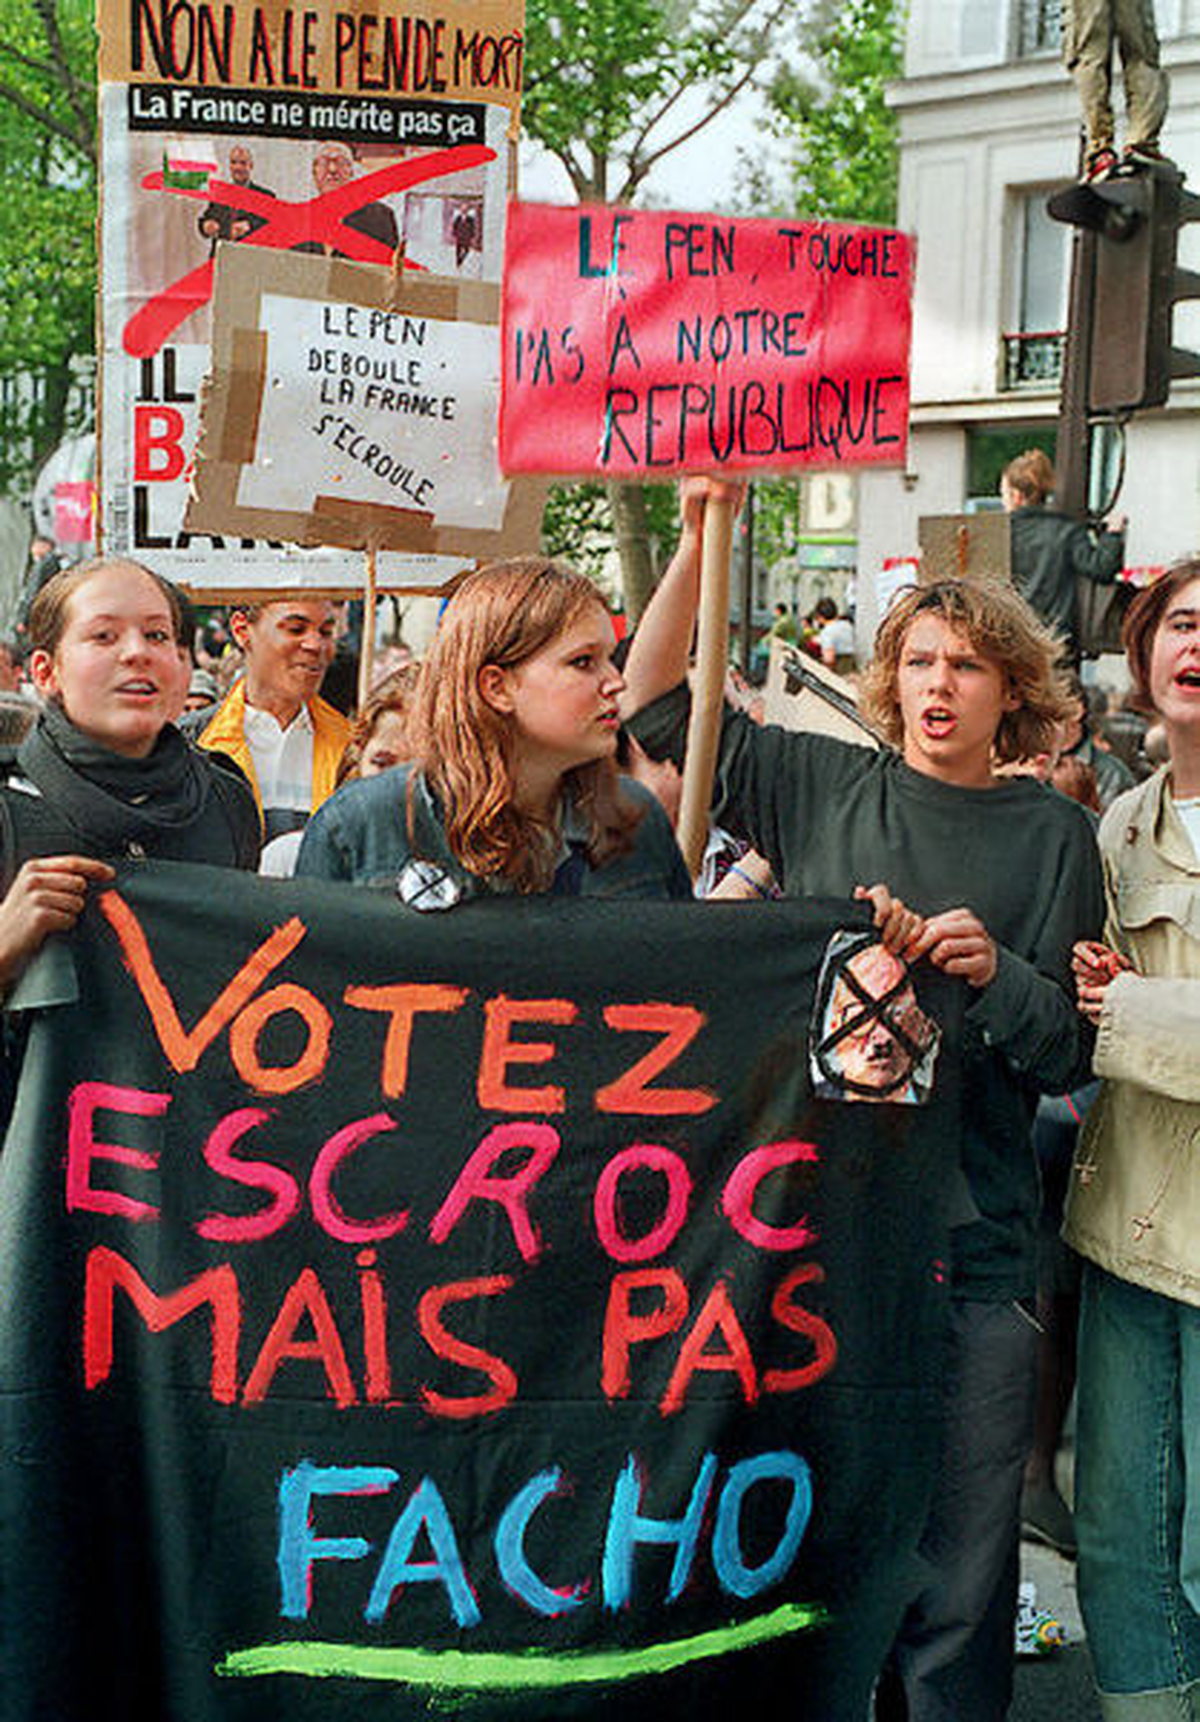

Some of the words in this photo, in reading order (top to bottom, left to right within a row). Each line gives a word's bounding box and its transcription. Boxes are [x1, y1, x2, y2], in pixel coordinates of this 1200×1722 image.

[131, 0, 235, 83] NON
[249, 7, 276, 86] A
[282, 10, 318, 89] LE
[453, 28, 525, 92] MORT
[133, 88, 168, 119] La
[172, 89, 266, 124] France
[271, 101, 304, 126] ne
[309, 99, 394, 131] mérite
[398, 110, 443, 139] pas
[447, 113, 477, 143] ça
[579, 214, 635, 279] LE
[778, 227, 899, 278] TOUCHE
[307, 348, 423, 387] DEBOULE
[323, 306, 359, 338] LE
[369, 310, 427, 346] PEN
[677, 308, 807, 363] NOTRE
[320, 378, 356, 405] LA
[364, 384, 456, 420] FRANCE
[602, 376, 902, 467] REPUBLIQUE
[311, 412, 436, 507] S'ECROULE
[98, 889, 720, 1116] VOTEZ
[65, 1081, 821, 1264] ESCROC
[602, 1263, 838, 1415] PAS
[276, 1449, 814, 1628] FACHO
